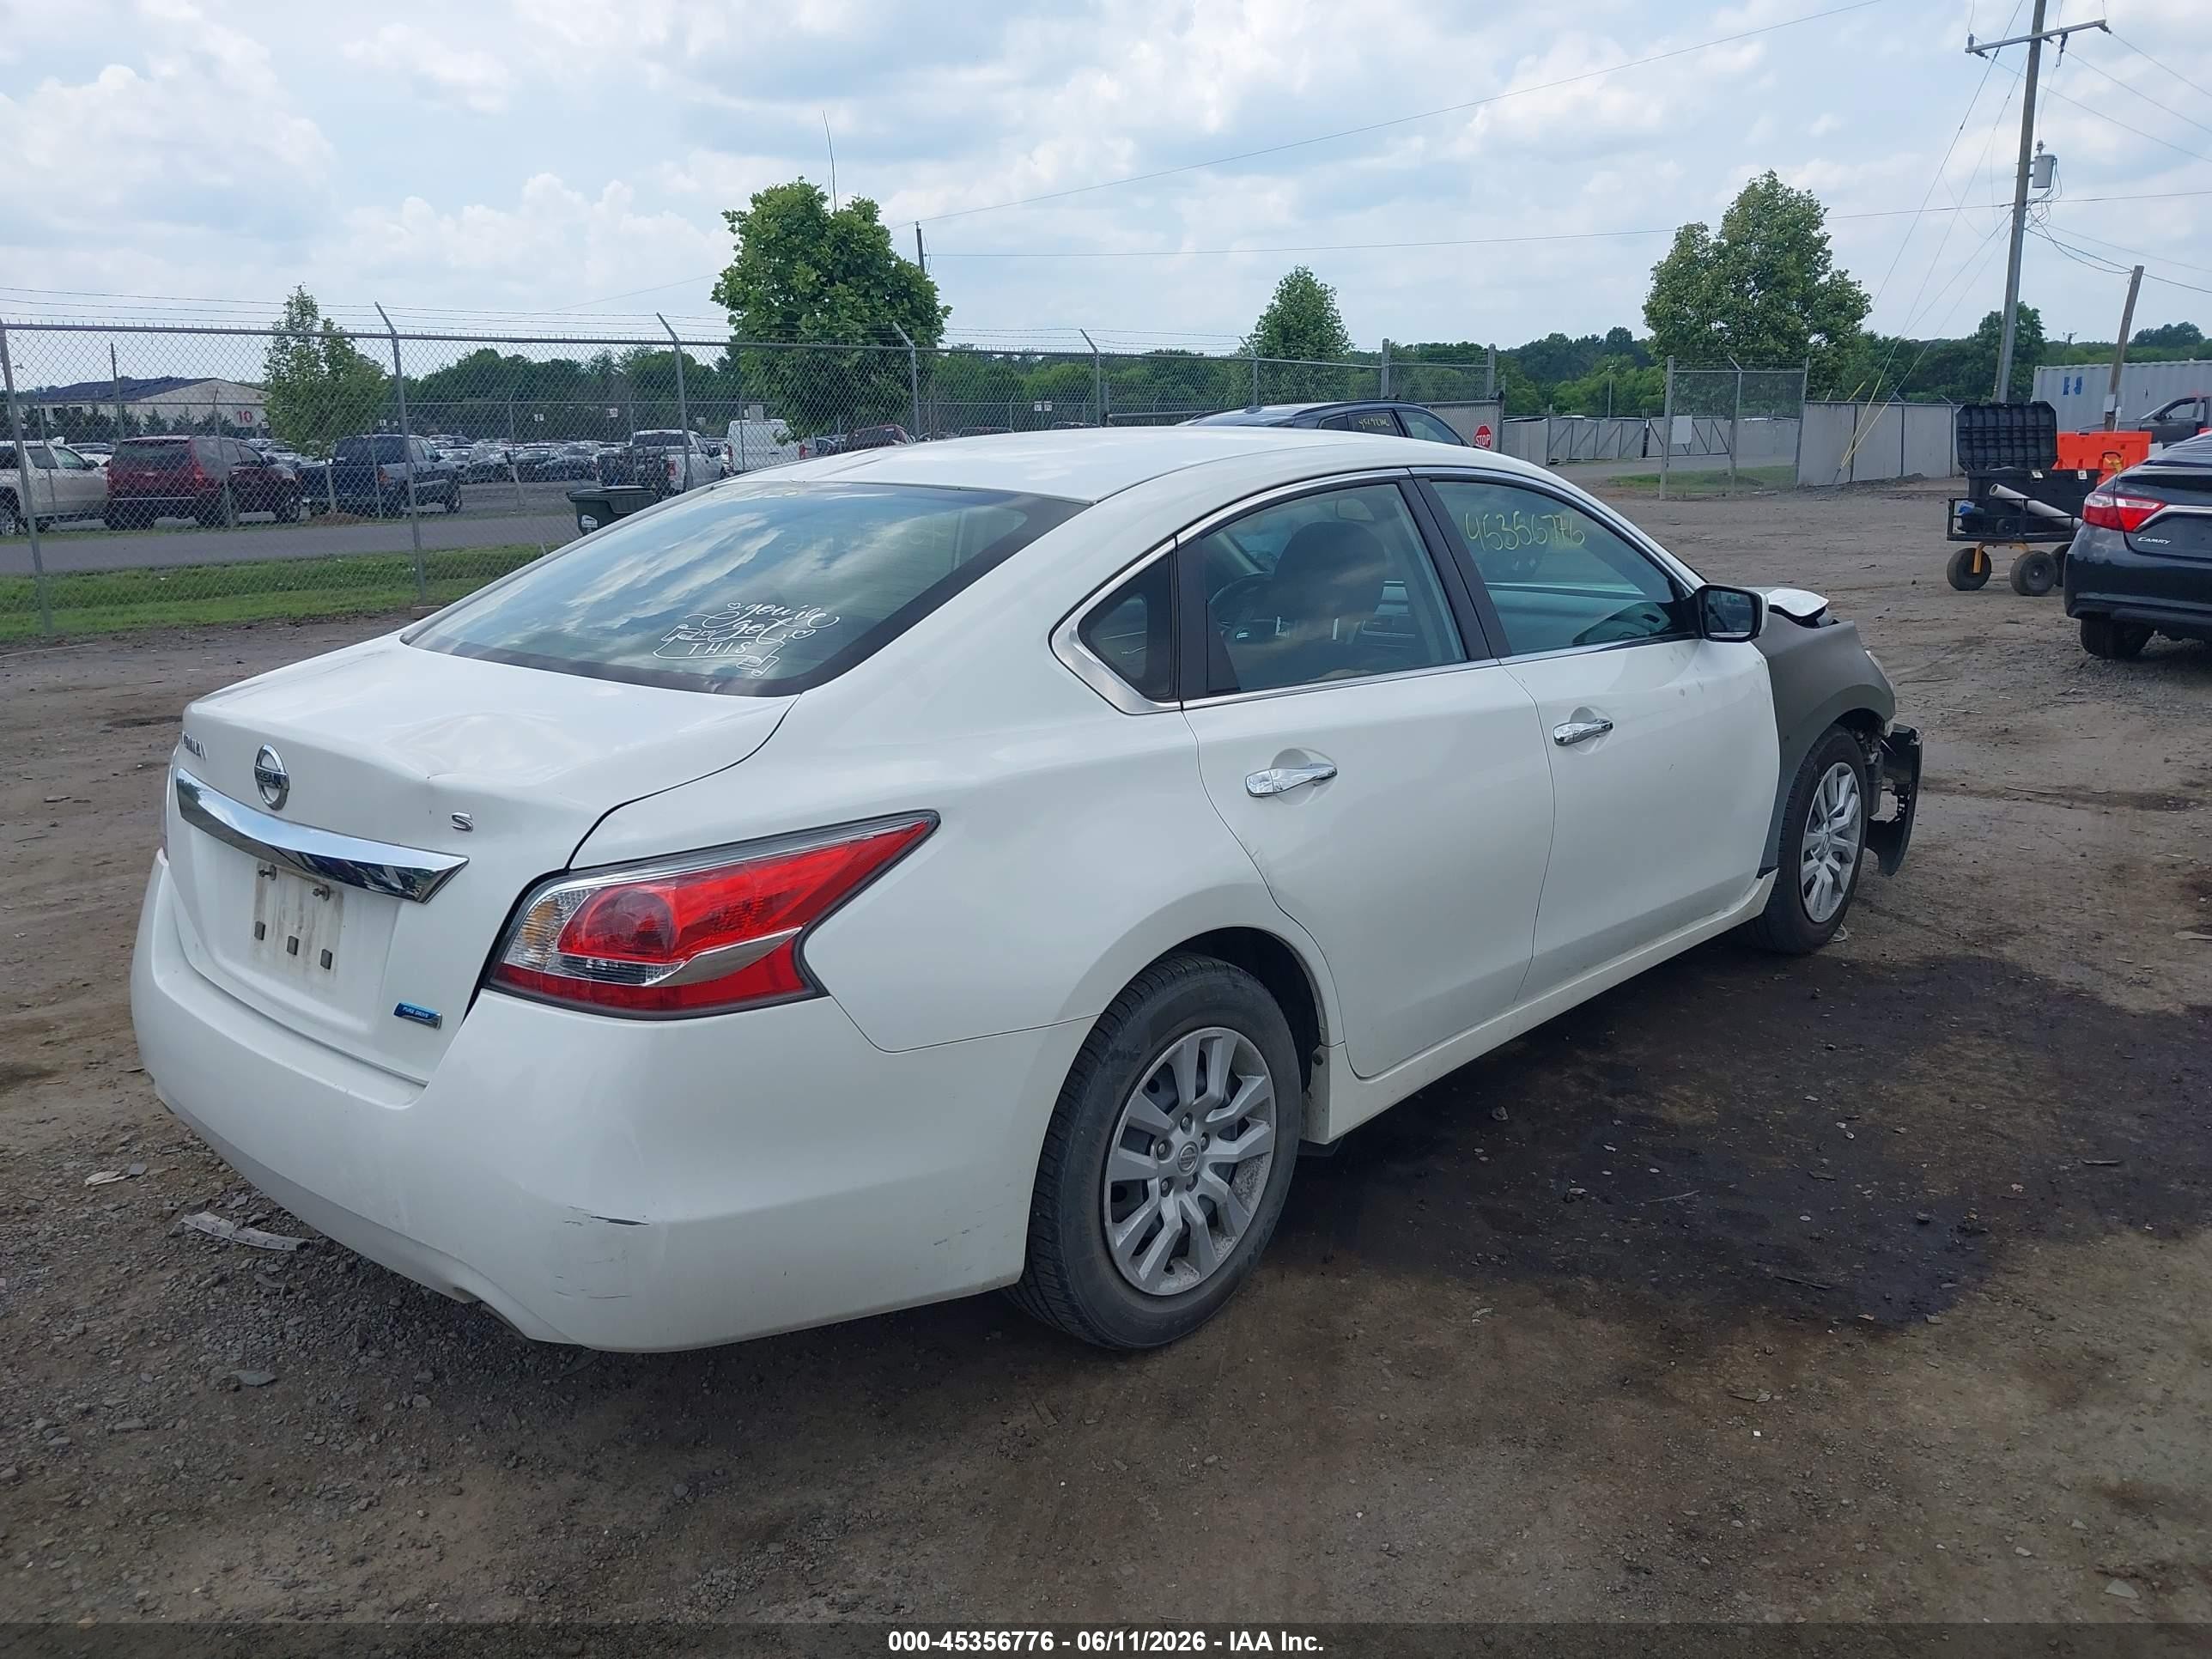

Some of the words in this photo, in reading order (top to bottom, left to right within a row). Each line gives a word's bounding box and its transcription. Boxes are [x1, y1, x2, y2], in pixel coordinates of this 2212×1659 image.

[236, 410, 253, 423] 10
[1475, 434, 1491, 447] STOP
[1465, 510, 1585, 551] 45356776
[2136, 536, 2172, 544] CAMRY
[688, 641, 752, 656] THIS
[451, 811, 474, 833] S
